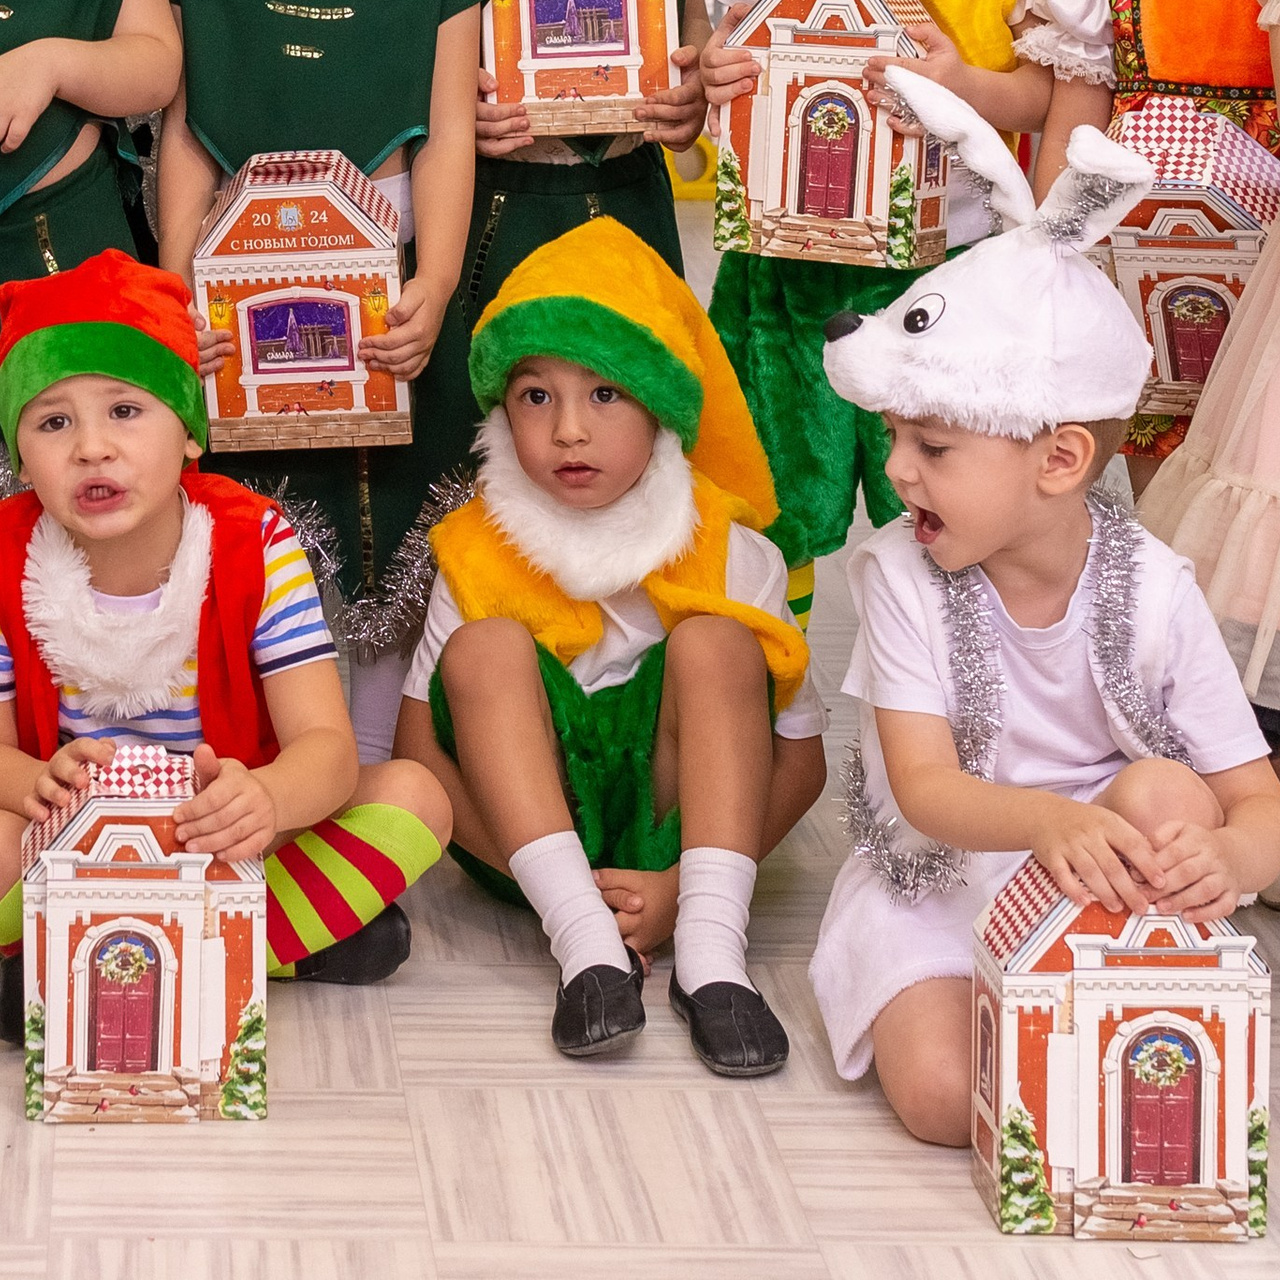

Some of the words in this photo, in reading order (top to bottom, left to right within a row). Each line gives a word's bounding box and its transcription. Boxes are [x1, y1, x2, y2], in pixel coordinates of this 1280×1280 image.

[252, 213, 271, 226] 20
[310, 210, 328, 223] 24
[230, 240, 240, 251] С
[243, 237, 297, 250] НОВЫМ
[300, 234, 355, 248] ГОДОМ!
